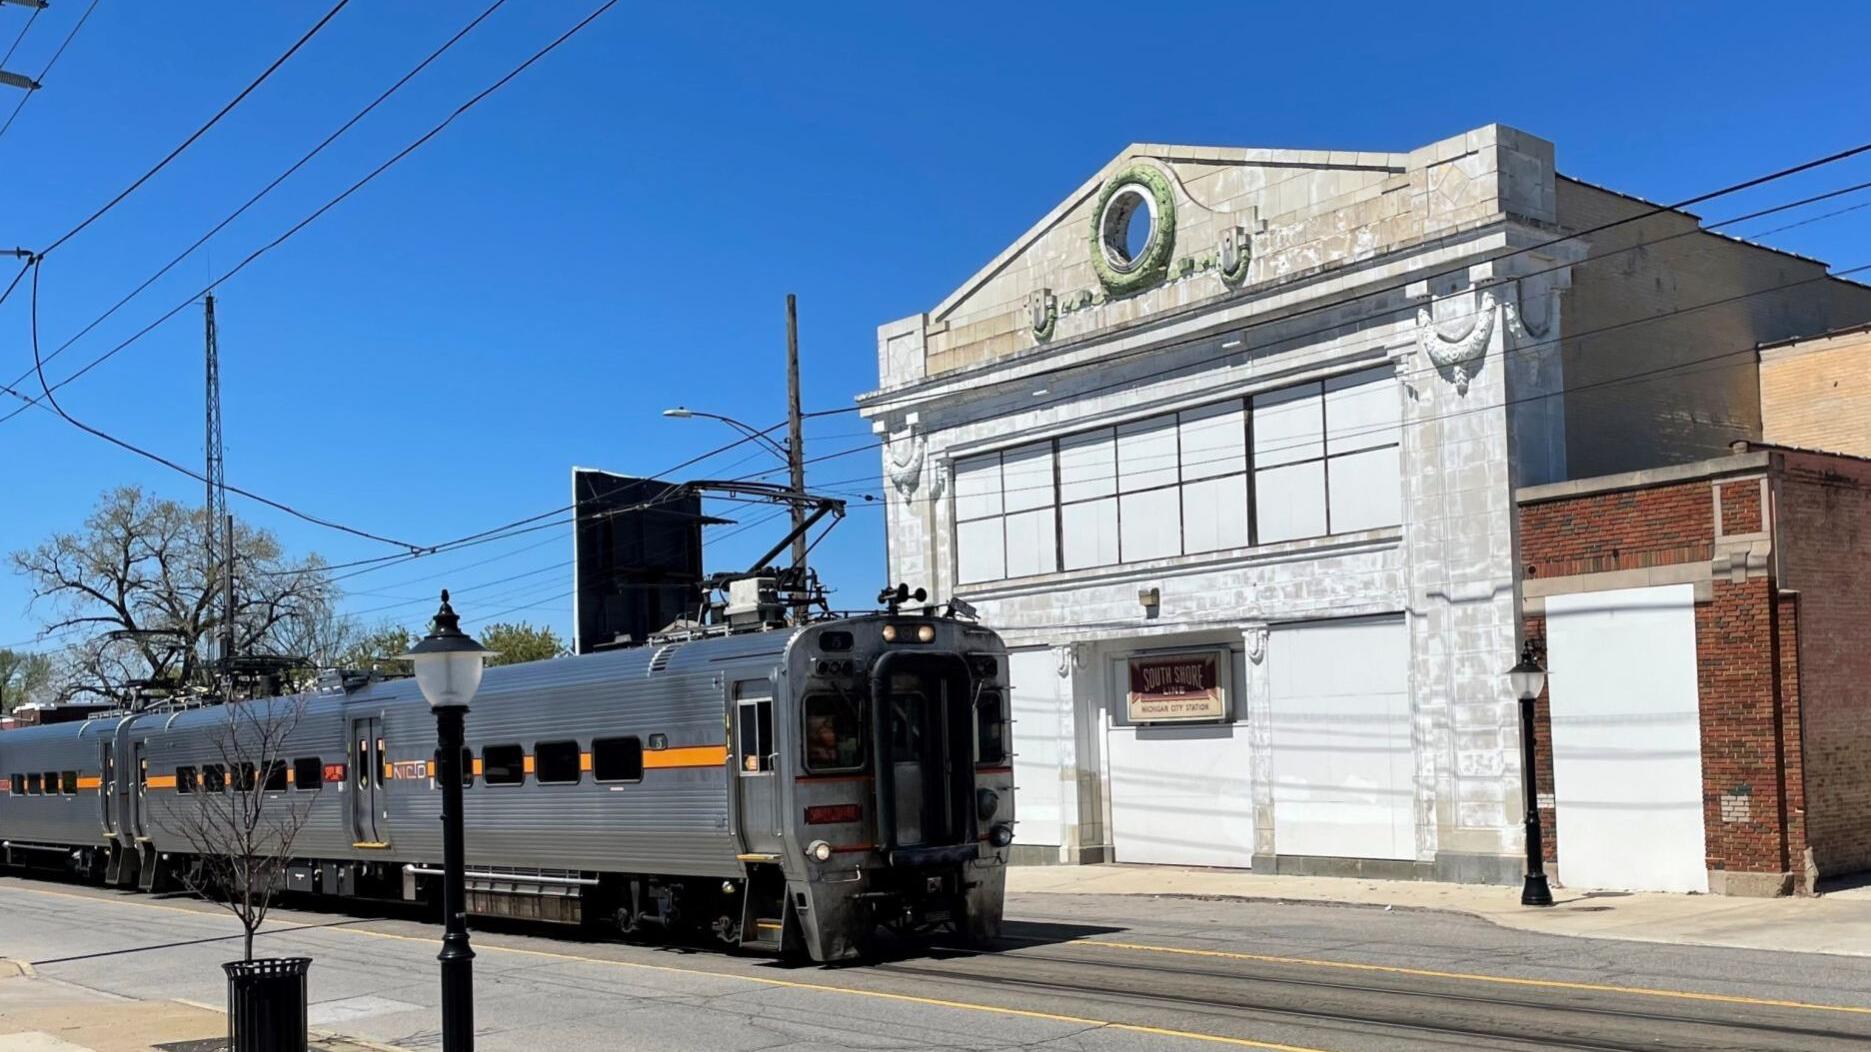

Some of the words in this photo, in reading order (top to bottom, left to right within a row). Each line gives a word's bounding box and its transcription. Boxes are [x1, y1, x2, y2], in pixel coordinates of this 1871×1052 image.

[1143, 666, 1172, 692] SOUTH
[1174, 664, 1204, 690] SHORE
[1163, 686, 1185, 695] LINE
[1170, 704, 1183, 712] CITY
[1186, 703, 1209, 711] STATION
